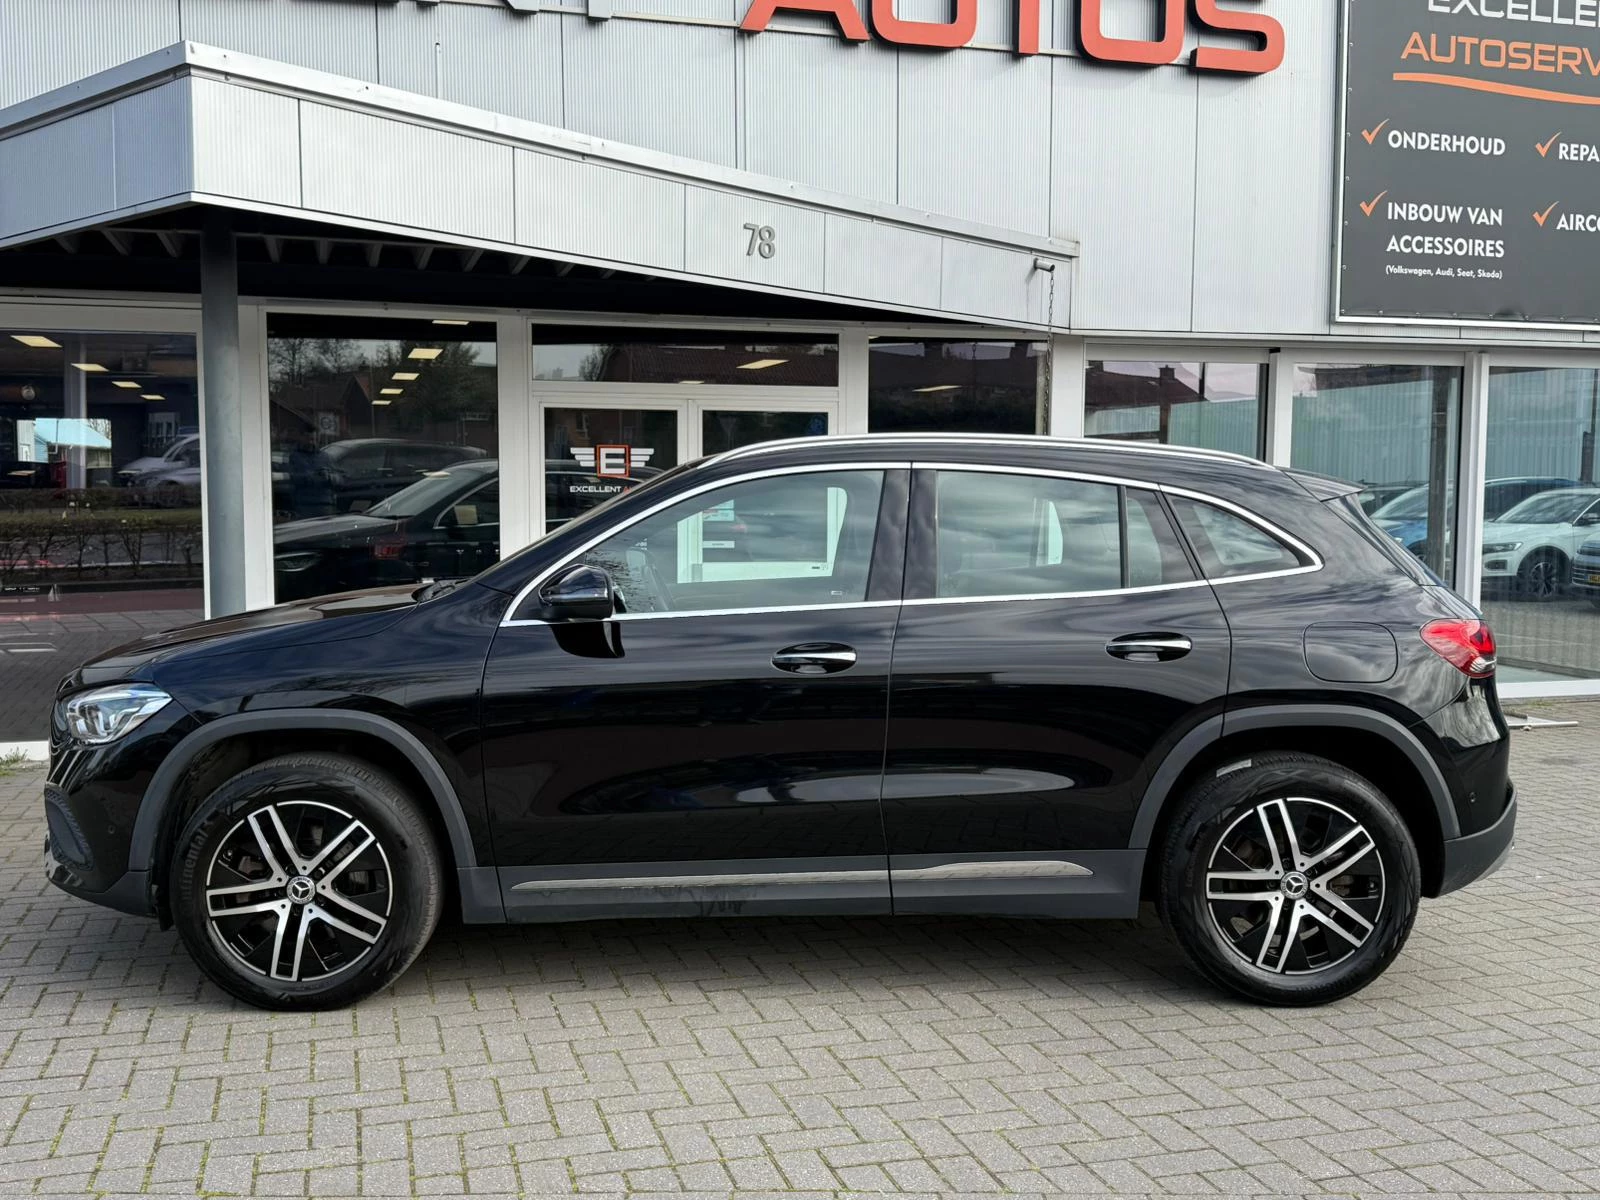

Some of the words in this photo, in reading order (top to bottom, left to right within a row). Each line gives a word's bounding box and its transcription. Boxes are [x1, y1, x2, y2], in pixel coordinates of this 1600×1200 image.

[1428, 0, 1600, 27] XCELLE
[1388, 130, 1505, 155] ONDERHOUD
[1559, 142, 1600, 162] REPA
[1387, 202, 1462, 223] INBOUW
[1468, 206, 1502, 226] VAN
[1556, 213, 1600, 232] AIRC
[743, 222, 775, 259] 78
[1386, 235, 1505, 257] ACCESSOIRES
[1386, 265, 1434, 277] (Volkswagen,
[1435, 267, 1455, 278] Audi,
[1457, 268, 1475, 279] Seat,
[1477, 269, 1503, 280] Skoda)
[569, 485, 621, 493] EXCELLENT
